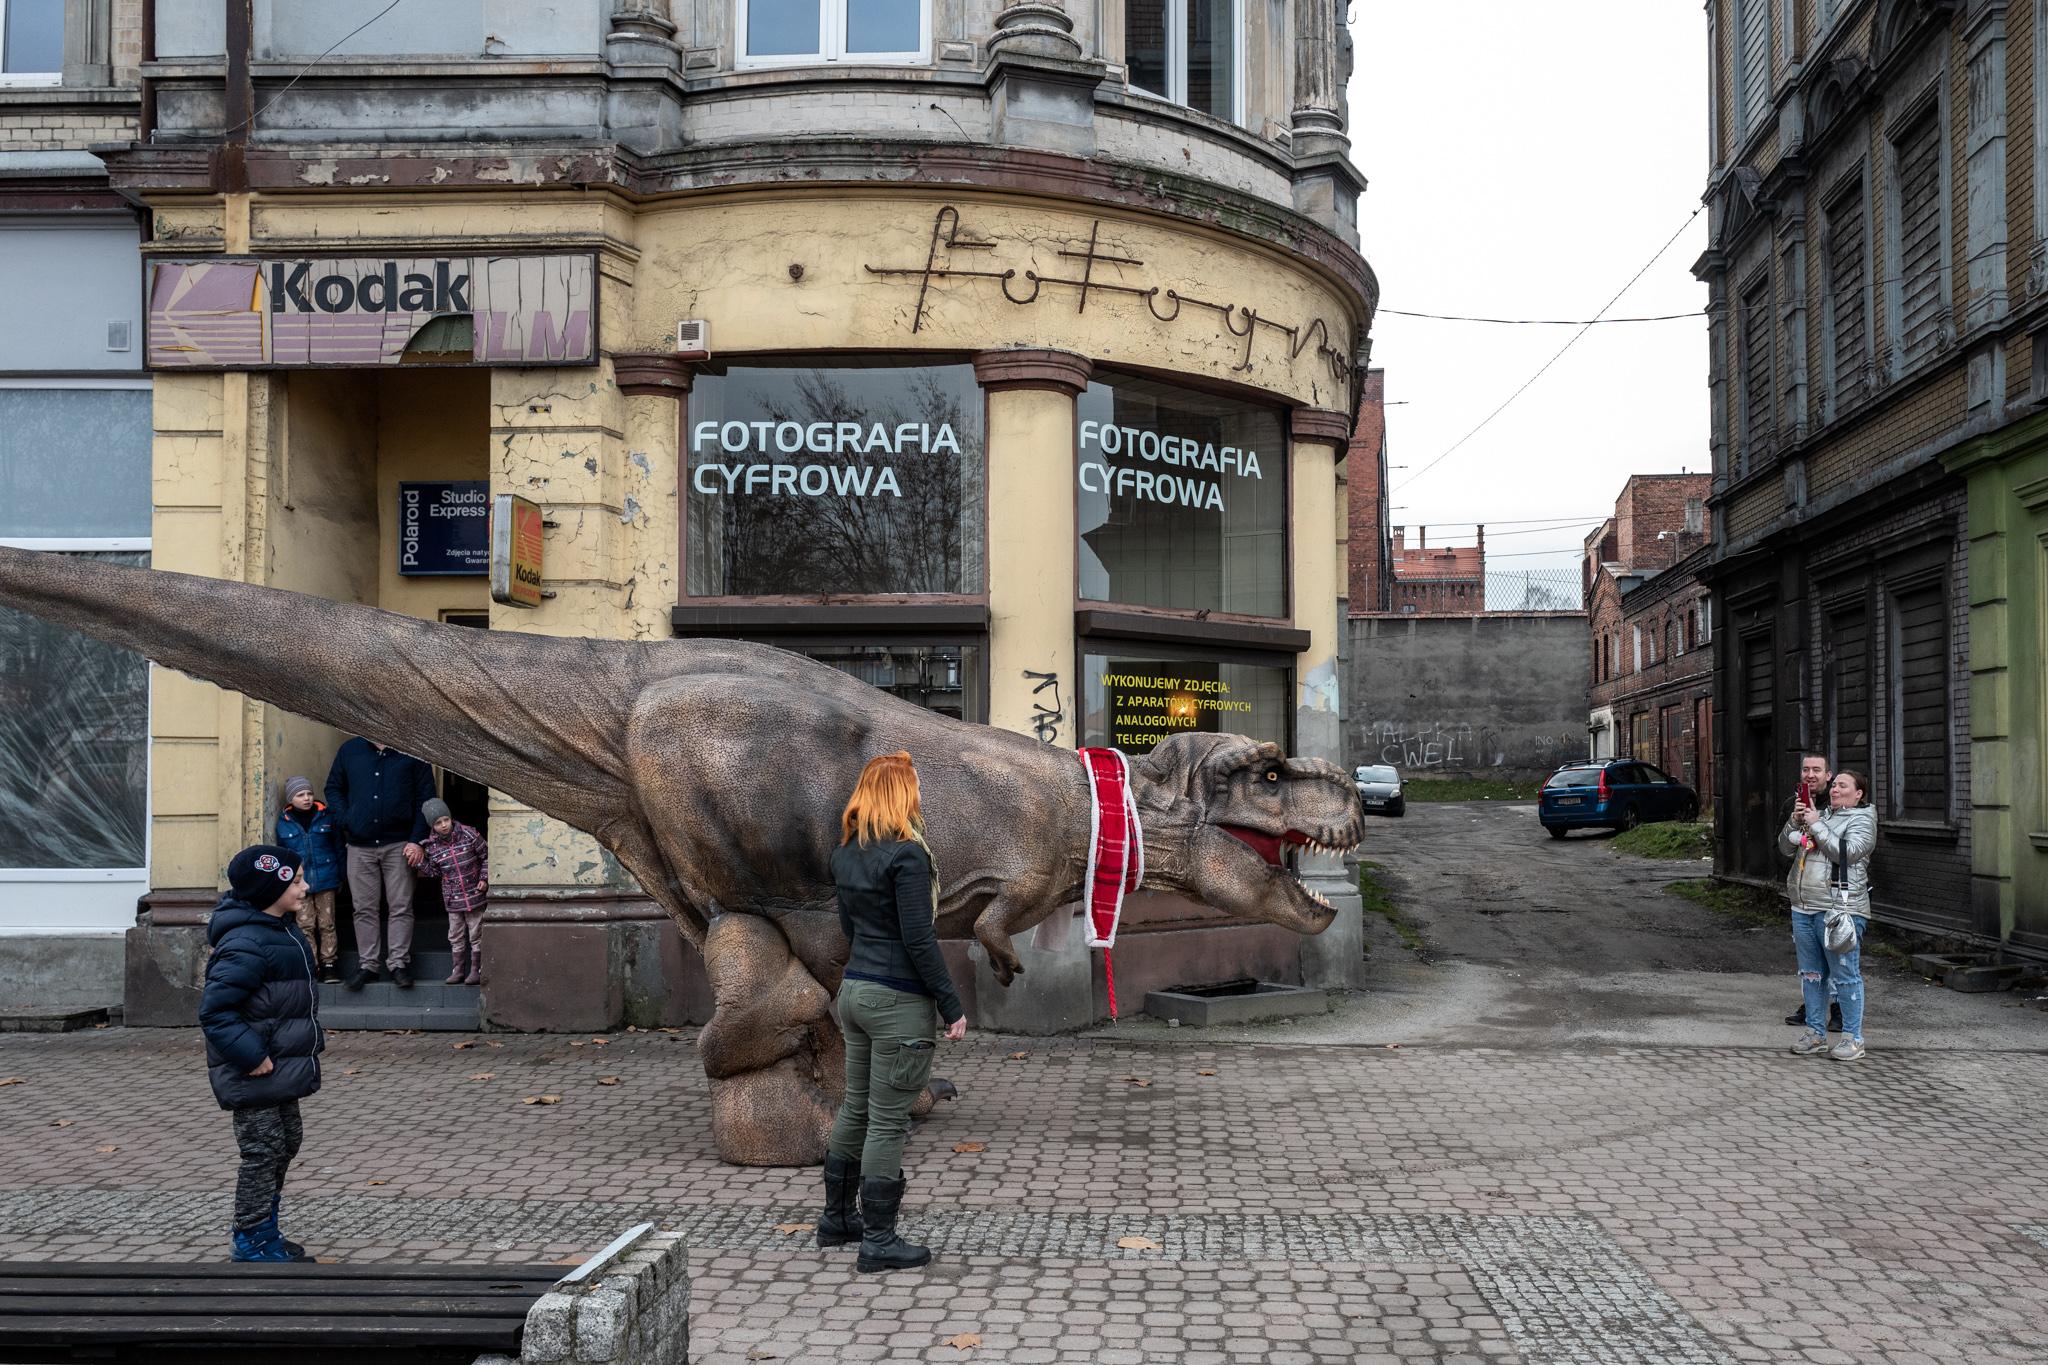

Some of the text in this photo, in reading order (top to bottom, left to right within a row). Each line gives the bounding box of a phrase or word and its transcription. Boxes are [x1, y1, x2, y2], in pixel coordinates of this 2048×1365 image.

[271, 262, 470, 313] Kodak
[694, 420, 961, 454] FOTOGRAFIA
[1080, 420, 1262, 480] FOTOGRAFIA
[694, 463, 902, 497] CYFROWA
[1079, 461, 1225, 512] CYFROWA
[441, 489, 486, 504] Studio
[430, 503, 486, 519] Express
[403, 490, 419, 566] Polaroid
[446, 549, 471, 557] Zdjęcia
[515, 563, 541, 587] Kodak
[1101, 674, 1231, 695] WYKONUJEMY ZDJĘCIA:
[1116, 695, 1251, 712] Z APARATÓW CYFROWYCH
[1115, 714, 1197, 728] ANALOGOWYCH
[1381, 740, 1464, 767] CWEL
